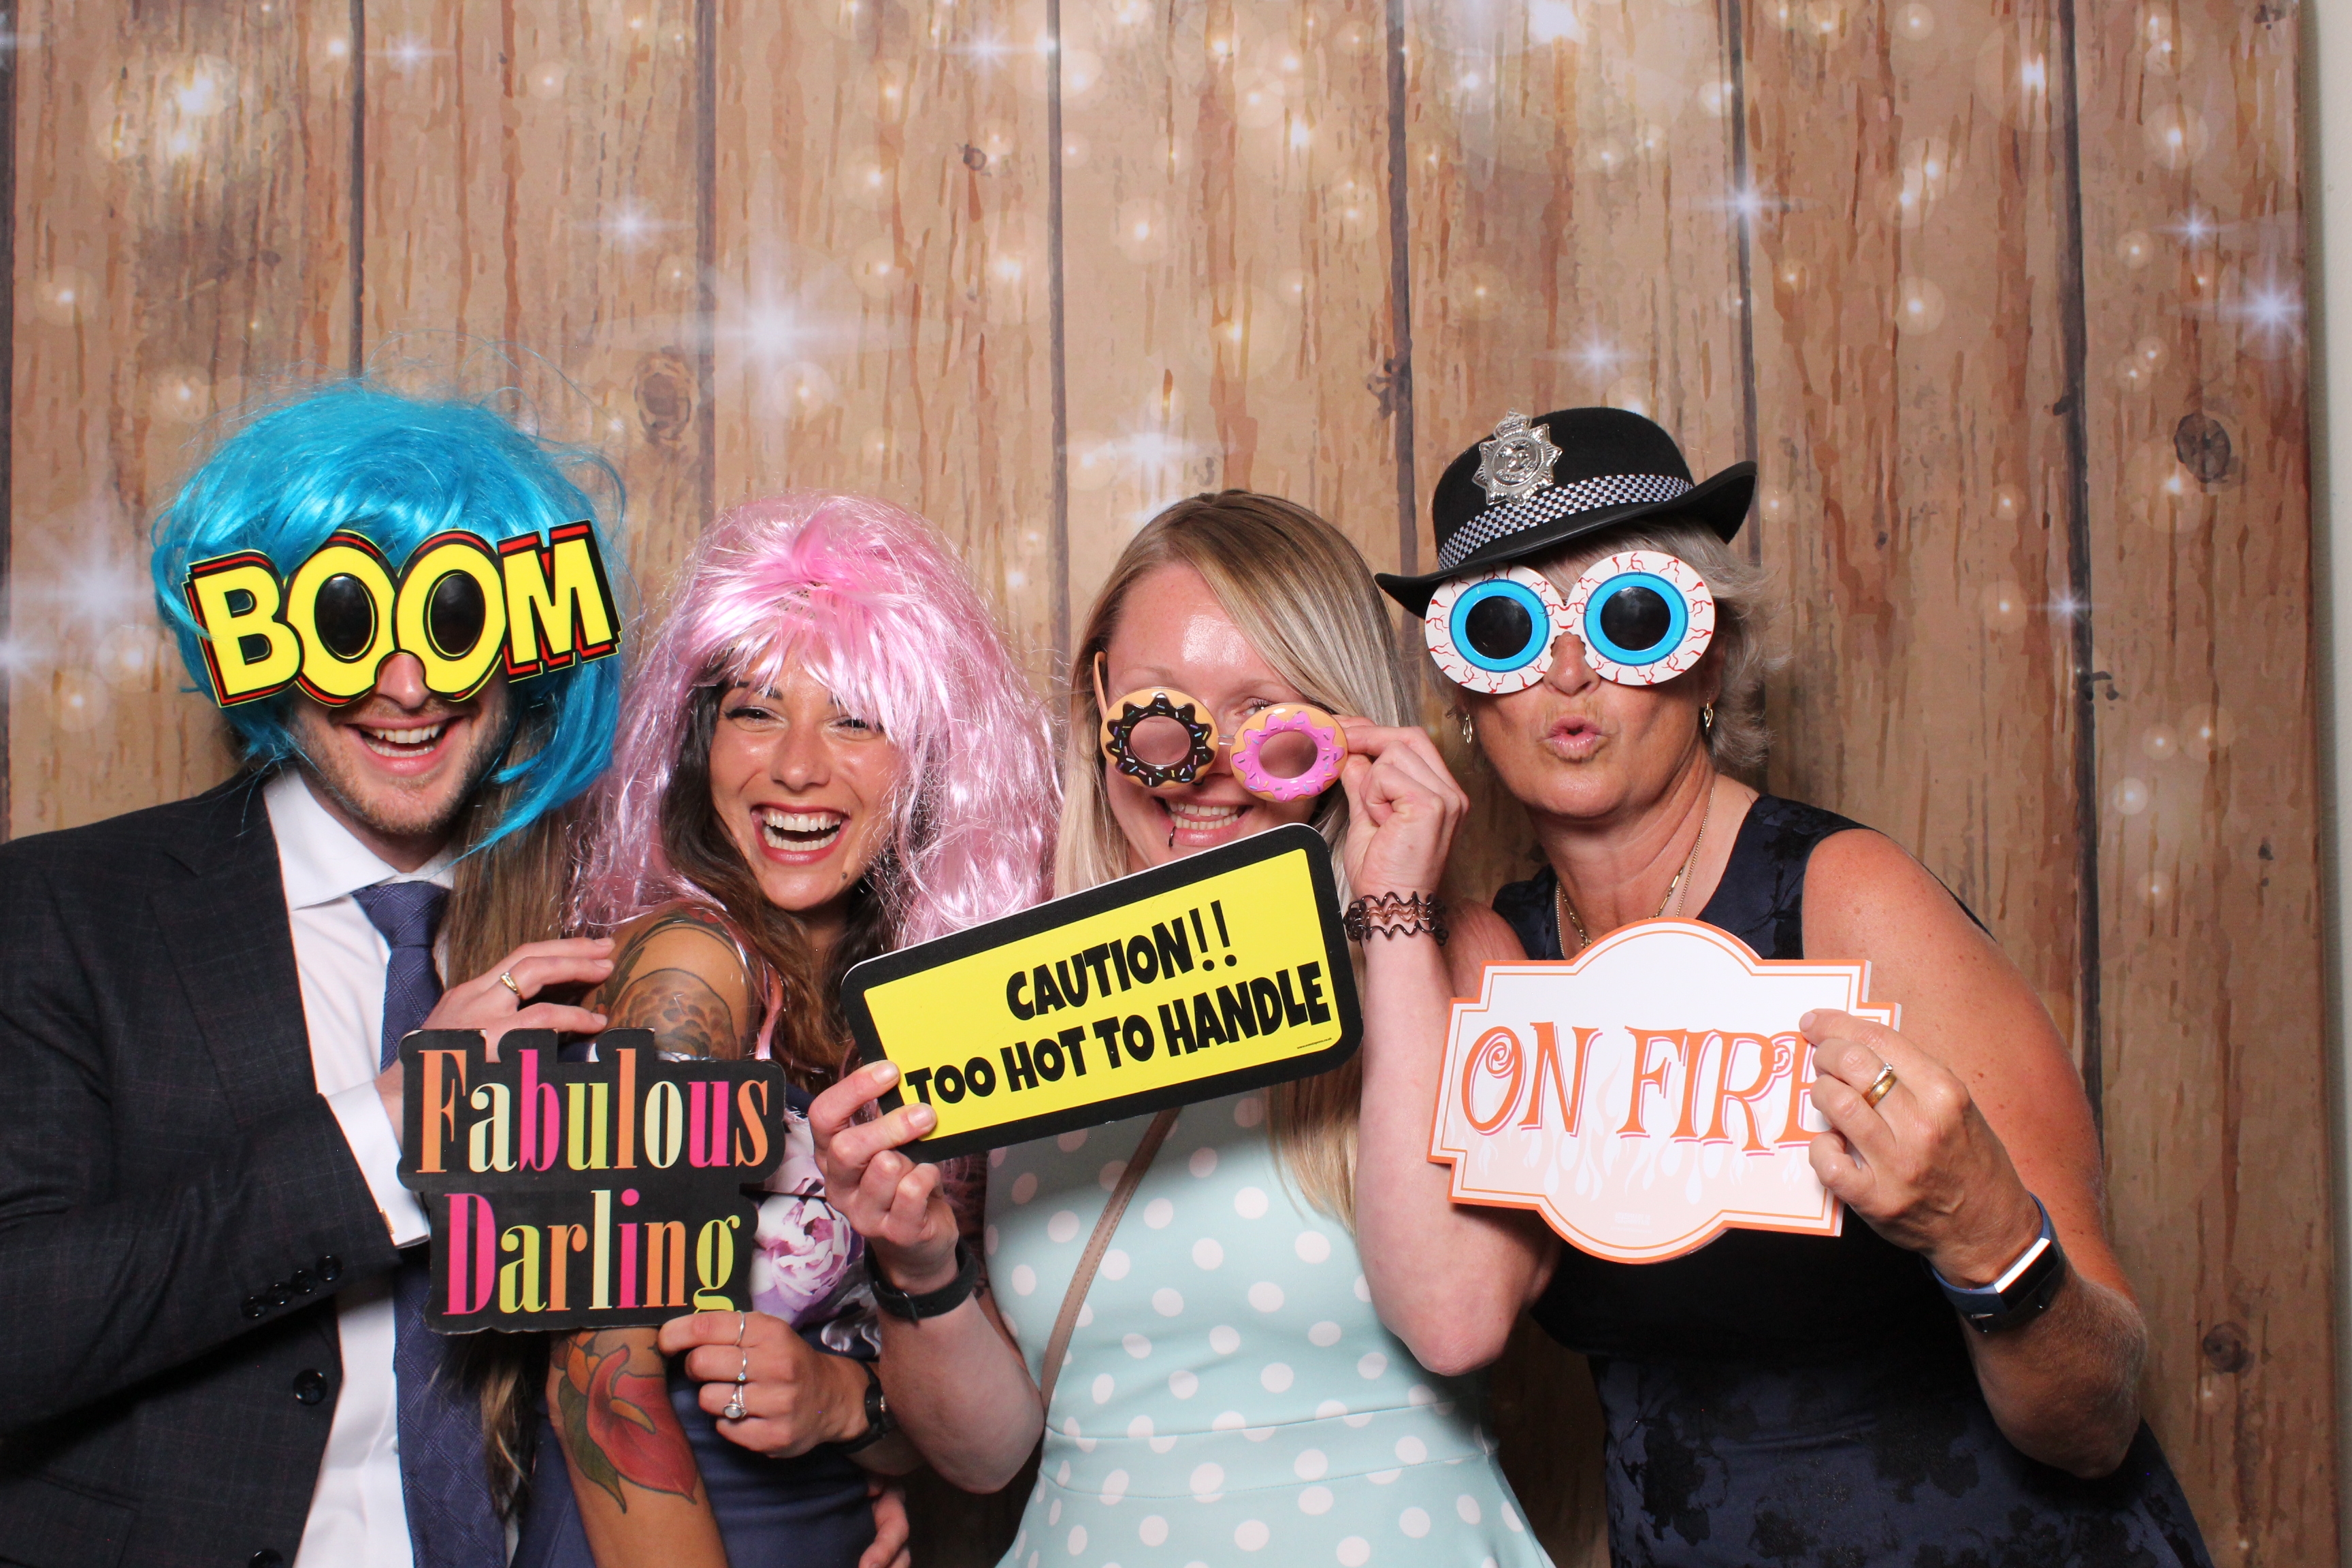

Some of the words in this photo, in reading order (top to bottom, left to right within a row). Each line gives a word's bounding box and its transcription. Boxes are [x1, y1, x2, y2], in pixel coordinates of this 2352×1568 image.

[185, 524, 618, 706] BOOM
[1005, 899, 1238, 1021] CAUTION!!
[904, 1056, 996, 1104] TOO
[1000, 1034, 1090, 1092] HOT
[1095, 1013, 1155, 1069] TO
[1158, 960, 1332, 1058] HANDLE
[1461, 1021, 1603, 1137] ON
[415, 1047, 768, 1173] Fabulous
[442, 1188, 740, 1316] Darling
